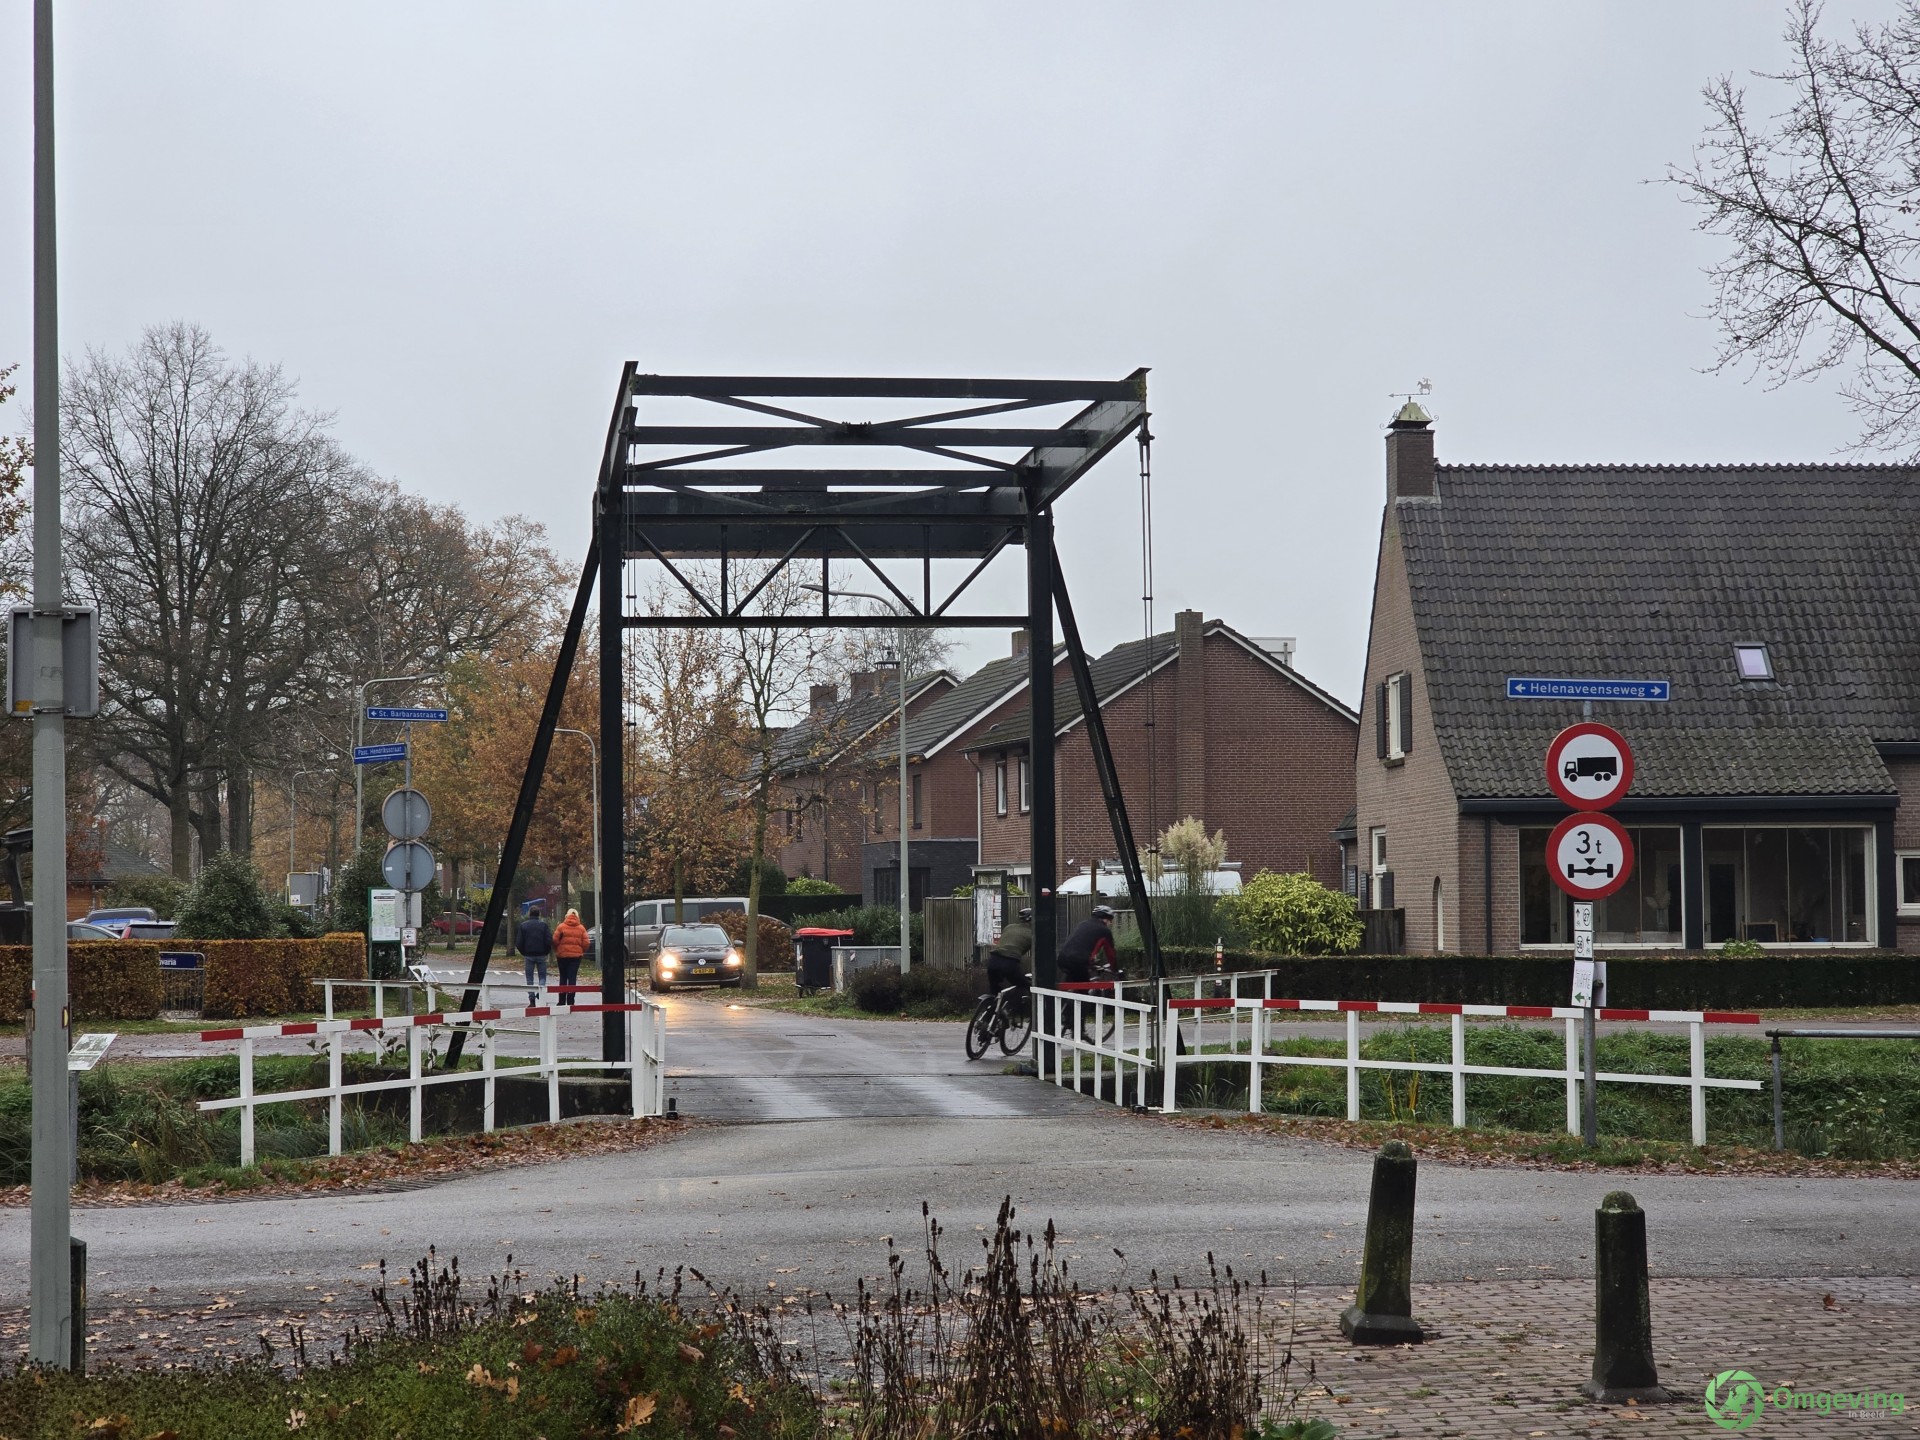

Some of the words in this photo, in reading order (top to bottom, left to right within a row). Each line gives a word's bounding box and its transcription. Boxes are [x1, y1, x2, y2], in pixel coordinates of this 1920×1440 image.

[1530, 682, 1646, 697] Helenaveenseweg
[378, 710, 389, 718] St.
[390, 710, 437, 719] Barbarastraat
[1575, 830, 1591, 855] 3
[1595, 839, 1602, 855] t
